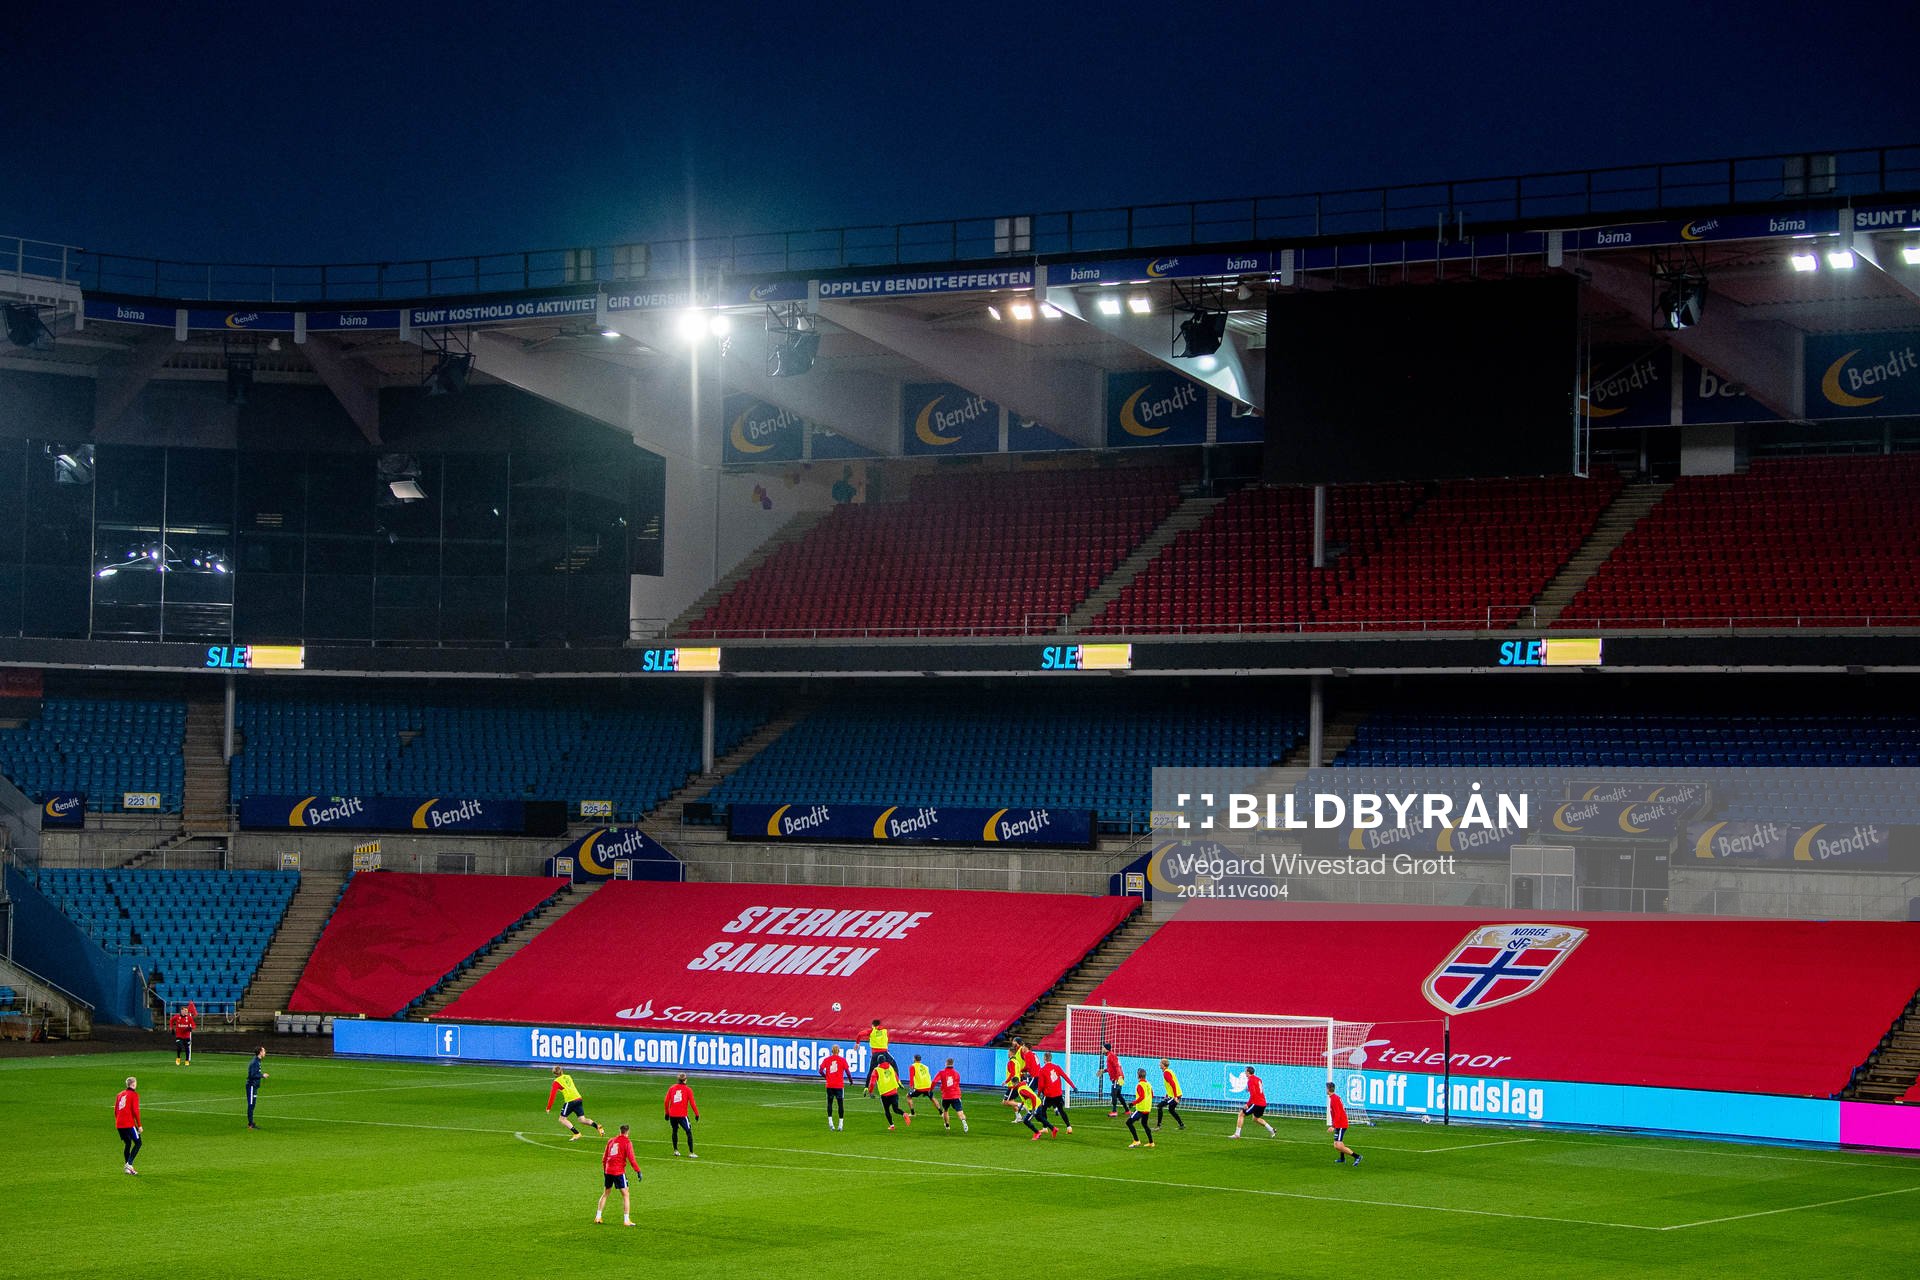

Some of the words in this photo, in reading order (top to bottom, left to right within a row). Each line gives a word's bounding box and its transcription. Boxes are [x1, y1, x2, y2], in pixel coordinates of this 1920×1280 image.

[1690, 219, 1719, 236] Bendit
[1856, 210, 1907, 226] SUNT
[1155, 257, 1179, 273] Bendit
[820, 280, 882, 295] OPPLEV
[884, 271, 1031, 292] BENDIT-EFFEKTEN
[414, 310, 446, 323] SUNT
[449, 304, 514, 321] KOSTHOLD
[516, 303, 534, 315] OG
[536, 298, 596, 313] AKTIVITET
[608, 296, 631, 308] GIR
[234, 313, 259, 324] Bendit
[1595, 360, 1659, 403] Bendit
[1847, 347, 1919, 391] Bendit
[935, 395, 989, 432] Bendit
[1140, 383, 1197, 422] Bendit
[749, 408, 799, 439] Bendit
[55, 797, 80, 812] Bendit
[127, 797, 145, 806] 223
[309, 797, 363, 825] Bendit
[431, 799, 483, 828] Bendit
[583, 805, 599, 814] 225
[1565, 803, 1600, 824] Bendit
[1631, 804, 1666, 825] Bendit
[784, 804, 830, 835] Bendit
[890, 806, 938, 838] Bendit
[1001, 808, 1050, 840] Bendit
[597, 830, 644, 863] Bendit
[1718, 822, 1779, 857] Bendit
[1816, 825, 1879, 860] Bendit
[721, 906, 934, 940] STERKERE
[1511, 928, 1551, 937] NORGE
[686, 942, 880, 977] SAMMEN
[652, 1005, 814, 1028] Santander
[531, 1029, 867, 1073] facebook.com/fotballandslaet
[1378, 1048, 1512, 1068] telenor
